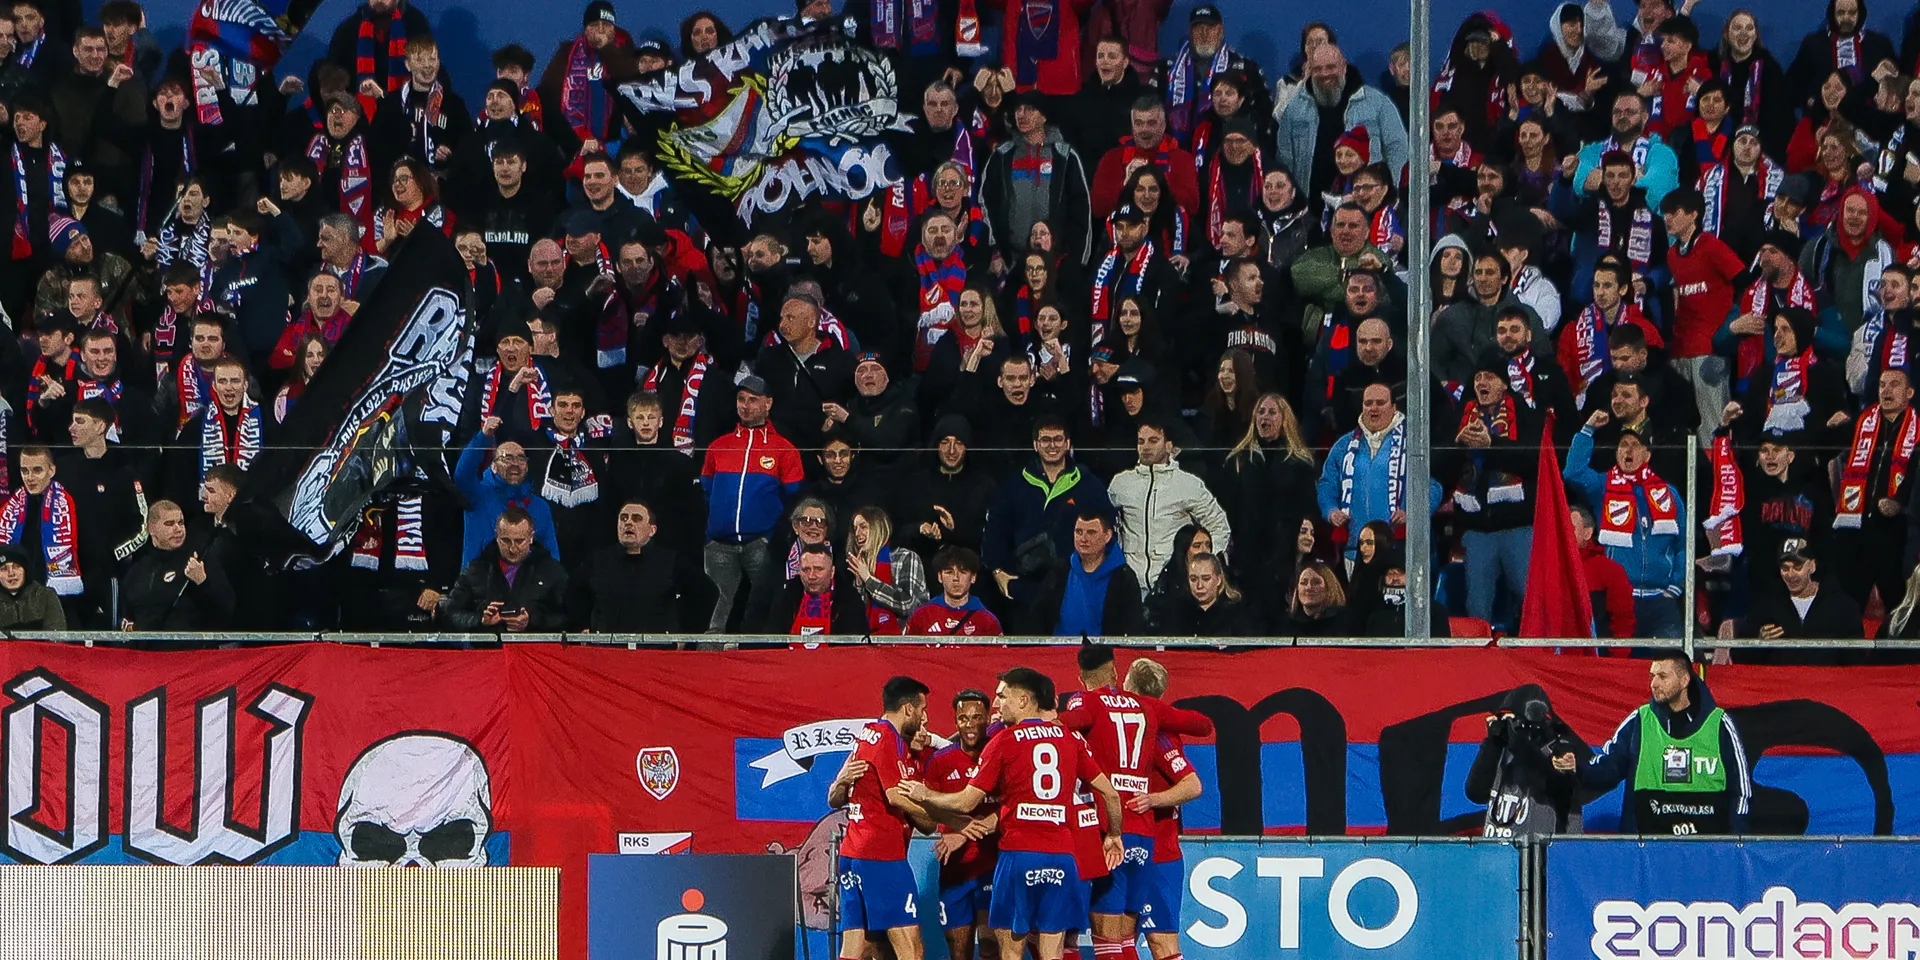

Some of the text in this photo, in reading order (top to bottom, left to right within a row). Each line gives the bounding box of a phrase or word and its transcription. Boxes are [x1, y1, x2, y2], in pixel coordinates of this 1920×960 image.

[203, 420, 226, 470] KOŃC
[1100, 695, 1140, 709] ROCHA
[792, 727, 857, 751] RKS
[1014, 726, 1064, 742] PIENKO
[1109, 711, 1146, 769] 17
[1033, 742, 1061, 800] 8
[1693, 757, 1718, 775] TV
[1113, 778, 1147, 791] NEONET
[1020, 806, 1063, 819] NEONET
[1672, 823, 1698, 836] 001
[623, 837, 650, 847] RKS
[904, 892, 917, 919] 4
[1186, 857, 1419, 950] STO
